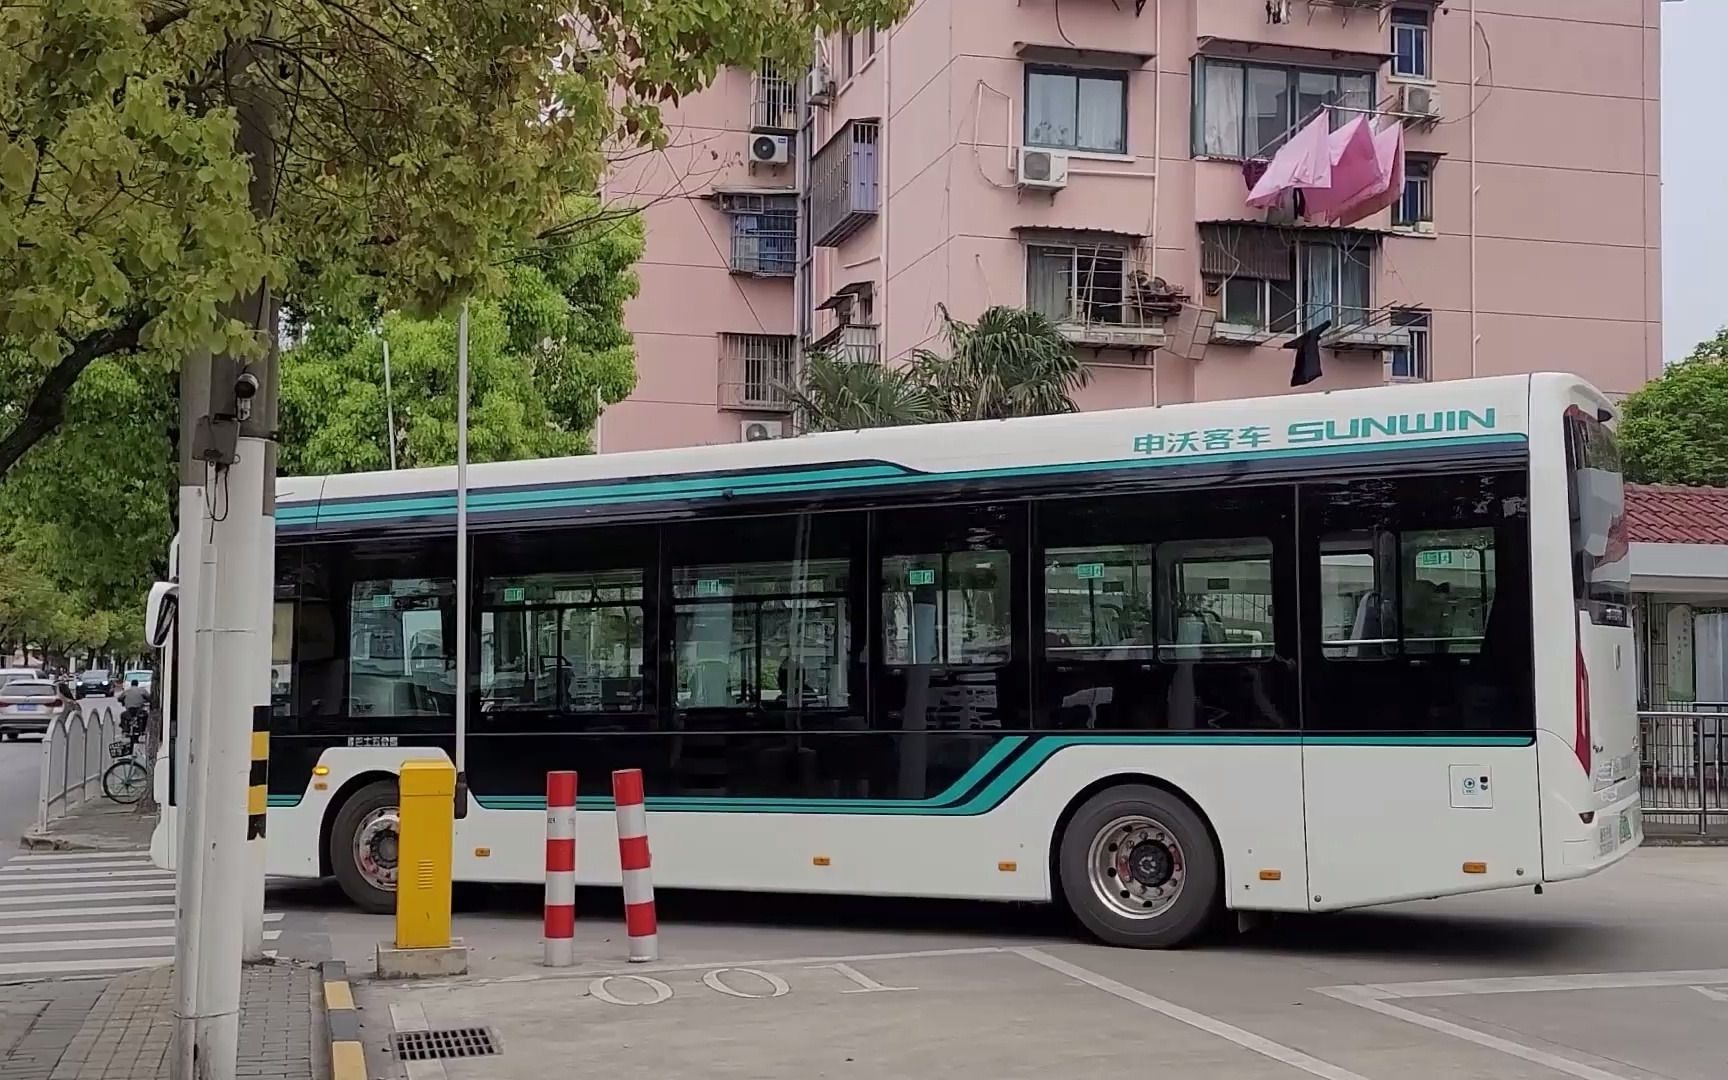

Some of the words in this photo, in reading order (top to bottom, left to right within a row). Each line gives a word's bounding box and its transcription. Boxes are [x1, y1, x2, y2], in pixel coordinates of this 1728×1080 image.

[1133, 425, 1271, 455] 申沃客车
[1288, 408, 1495, 443] SUNWIN
